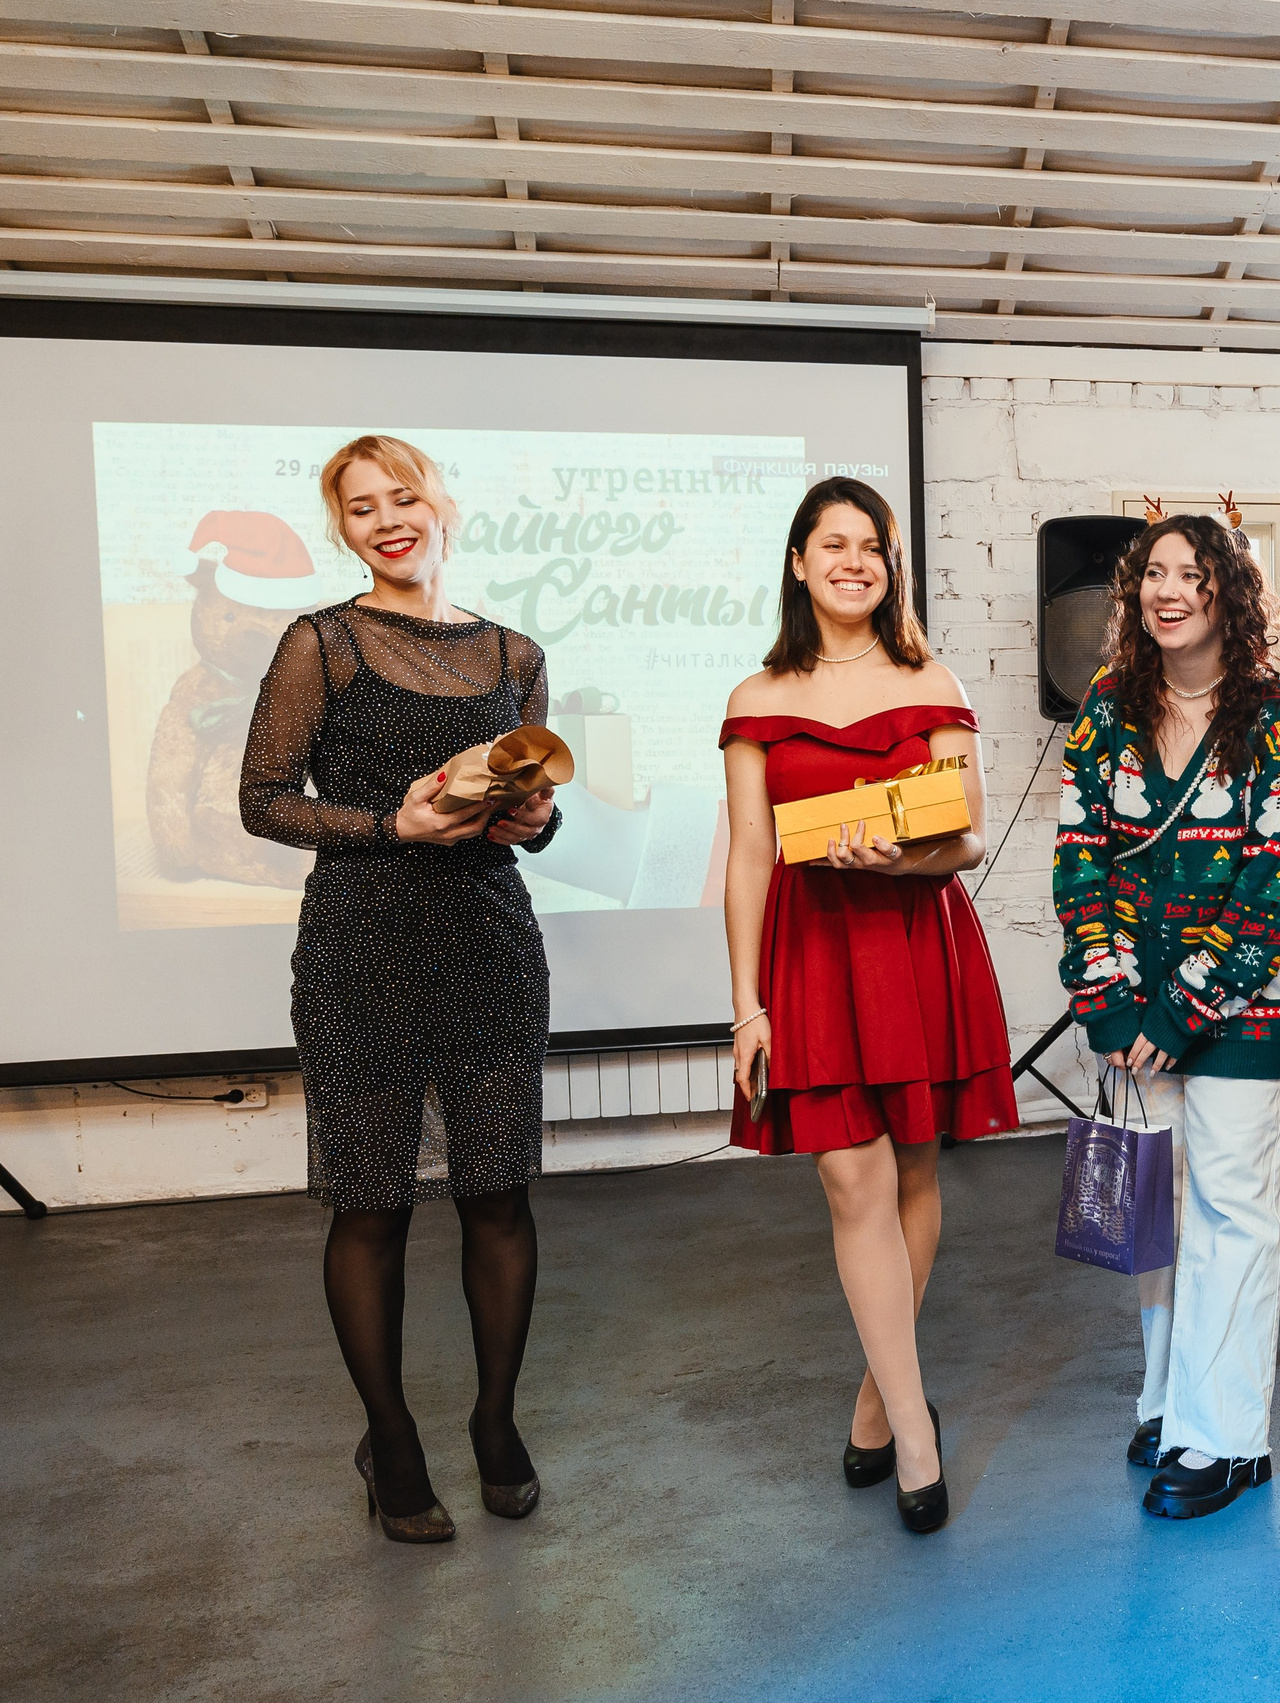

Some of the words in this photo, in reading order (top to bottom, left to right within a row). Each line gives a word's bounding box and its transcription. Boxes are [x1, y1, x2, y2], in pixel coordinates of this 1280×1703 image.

[275, 459, 301, 477] 29
[551, 465, 766, 502] утренник
[722, 457, 818, 478] Функция
[823, 459, 889, 478] паузы
[454, 494, 686, 556] айного
[486, 557, 769, 647] Санты
[646, 647, 758, 670] #читалка
[1164, 902, 1192, 914] 100
[1241, 920, 1265, 934] 100
